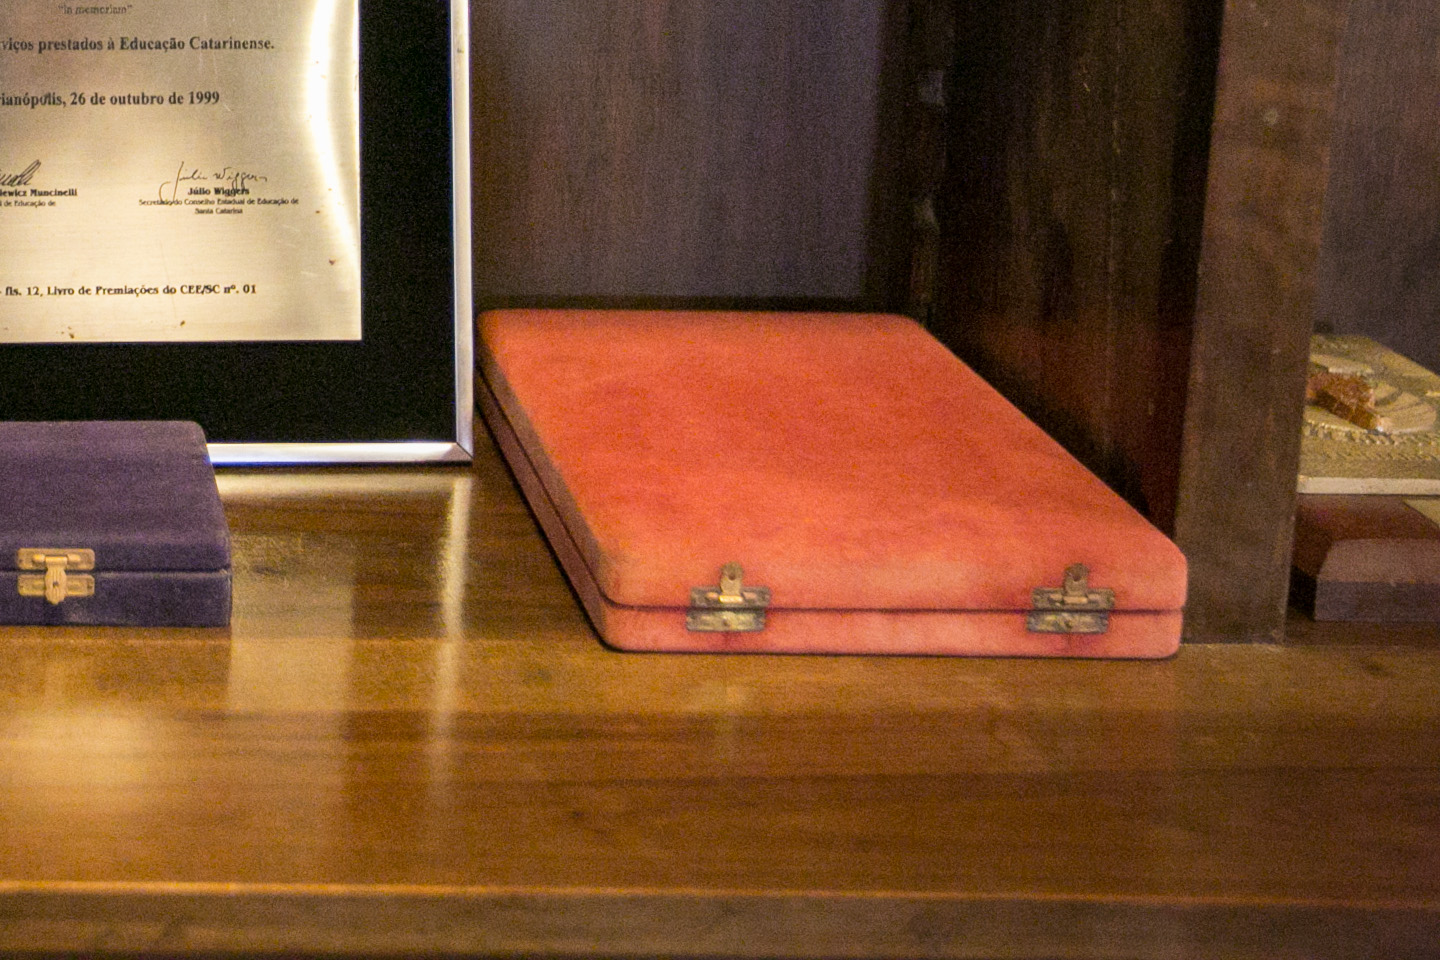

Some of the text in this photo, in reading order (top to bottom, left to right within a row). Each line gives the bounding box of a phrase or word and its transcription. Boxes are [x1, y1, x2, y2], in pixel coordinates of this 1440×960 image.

[38, 38, 103, 54] prestados
[107, 38, 115, 50] à
[120, 37, 185, 53] Educação
[189, 36, 275, 50] Catarinense.
[70, 92, 86, 105] 26
[90, 92, 106, 105] de
[110, 92, 164, 105] outubro
[168, 92, 184, 105] de
[189, 91, 220, 105] 1999
[26, 286, 43, 298] 12,
[47, 286, 74, 296] Livro
[78, 286, 92, 295] de
[95, 284, 159, 298] Premiações
[162, 285, 177, 295] do
[180, 284, 221, 295] CEE/SC
[242, 284, 257, 294] 01
